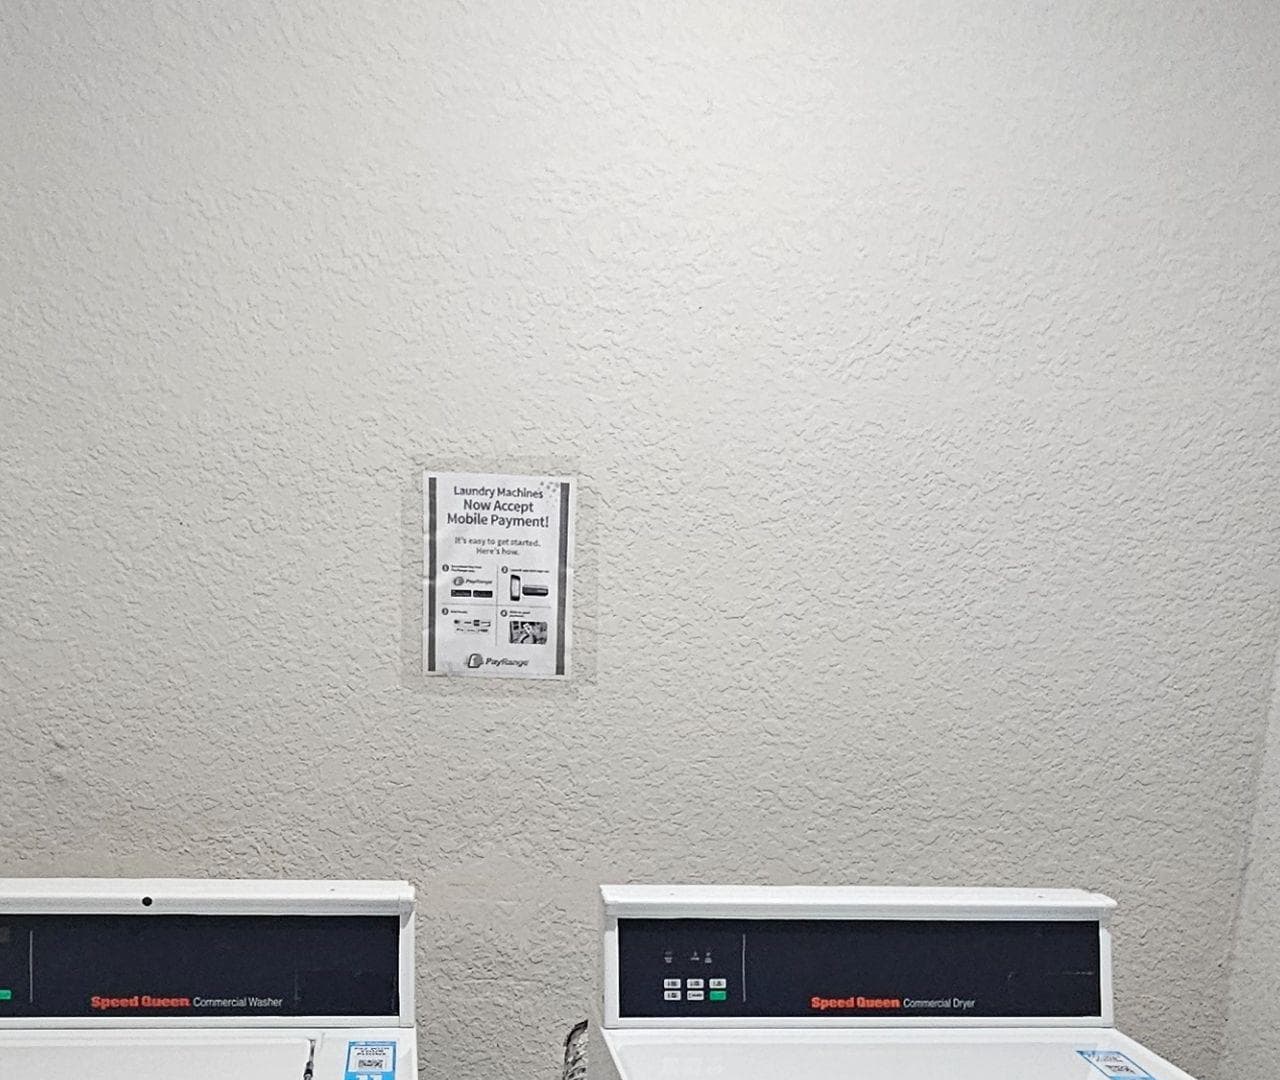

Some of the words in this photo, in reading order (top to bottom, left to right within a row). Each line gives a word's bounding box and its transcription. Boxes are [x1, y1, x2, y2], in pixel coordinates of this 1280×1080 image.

[453, 486, 494, 498] Laundry
[497, 488, 543, 498] Machines
[463, 499, 492, 511] Now
[493, 500, 534, 514] Accept
[447, 513, 488, 525] Mobile
[491, 515, 549, 529] Payment!
[455, 536, 467, 545] It's
[497, 539, 509, 547] get
[476, 547, 500, 555] Here's
[90, 996, 139, 1009] Speed
[141, 996, 190, 1007] Queen
[193, 997, 247, 1007] Commercial
[248, 997, 282, 1007] Washer
[811, 997, 855, 1010] Speed
[857, 997, 900, 1008] Queen
[903, 998, 951, 1008] Commercial
[953, 998, 975, 1010] Dryer
